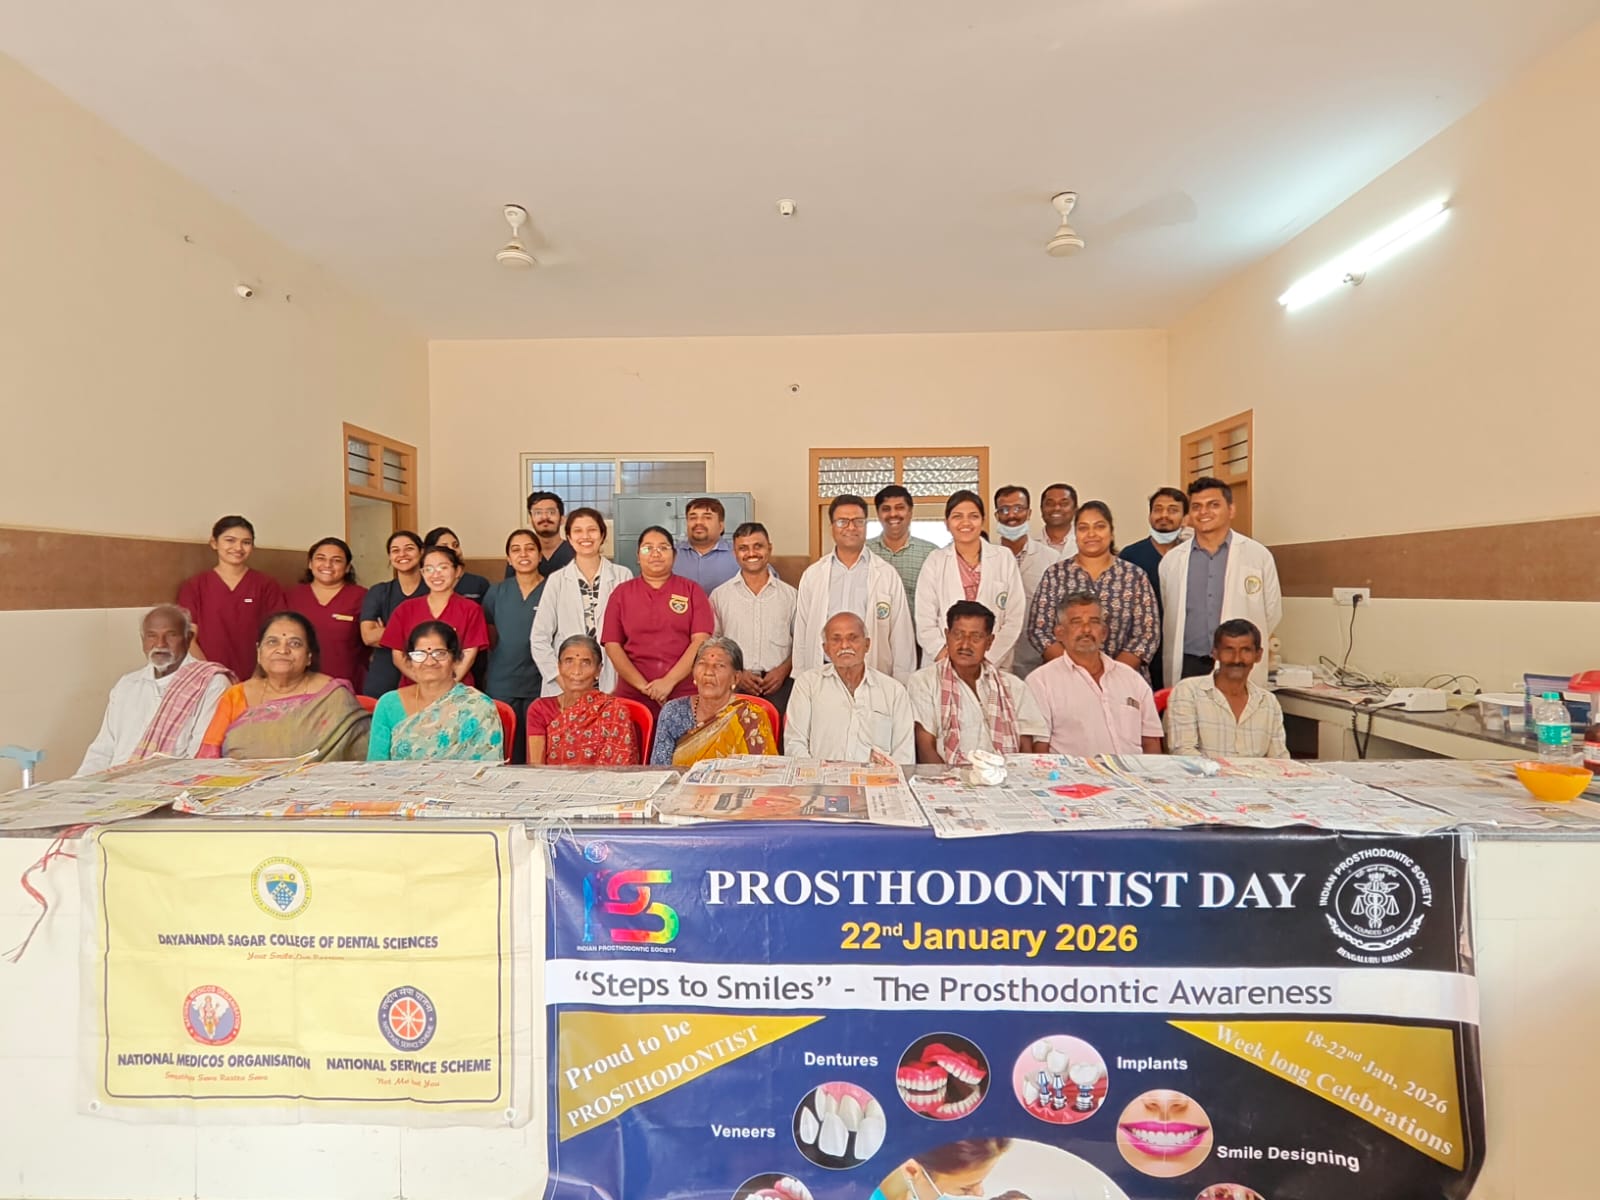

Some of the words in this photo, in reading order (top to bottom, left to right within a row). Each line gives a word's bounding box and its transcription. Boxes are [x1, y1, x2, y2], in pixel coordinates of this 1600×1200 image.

[705, 869, 1188, 908] PROSTHODONTIST
[1198, 872, 1306, 909] DAY
[1319, 874, 1338, 907] INDIAN
[1334, 848, 1415, 876] PROSTHODONTIC
[1411, 864, 1433, 908] SOCIETY
[157, 933, 226, 946] DAYANANDA
[227, 934, 267, 947] SAGAR
[269, 933, 316, 949] COLLEGE
[318, 936, 335, 949] OF
[336, 935, 380, 949] DENTAL
[382, 936, 439, 950] SCIENCES
[840, 921, 903, 950] 22nd
[902, 921, 1047, 958] January
[1055, 923, 1138, 952] 2026
[679, 975, 708, 997] to
[873, 977, 930, 1002] The
[940, 977, 1159, 1004] Prosthodontic
[1168, 979, 1332, 1006] Awareness
[118, 1053, 174, 1066] NATIONAL
[176, 1053, 224, 1068] MEDICOS
[227, 1054, 311, 1070] ORGANISATION
[326, 1058, 387, 1072] NATIONAL
[390, 1059, 437, 1074] SERVICE
[440, 1059, 491, 1073] SCHEME
[564, 1043, 634, 1090] Proud
[637, 1036, 661, 1056] to
[661, 1019, 693, 1044] be
[804, 1052, 879, 1067] Dentures
[1116, 1055, 1188, 1073] Implants
[566, 1025, 759, 1128] PROSTHODONTIST
[1304, 1030, 1363, 1062] 18-22nd
[1362, 1060, 1399, 1091] Jan,
[1403, 1080, 1449, 1115] 2026
[1216, 1025, 1266, 1062] Week
[1270, 1050, 1313, 1087] long
[1315, 1073, 1454, 1157] Celebrations
[711, 1124, 776, 1138] Veneers
[1216, 1146, 1263, 1160] Smile
[1267, 1147, 1361, 1173] Designing
